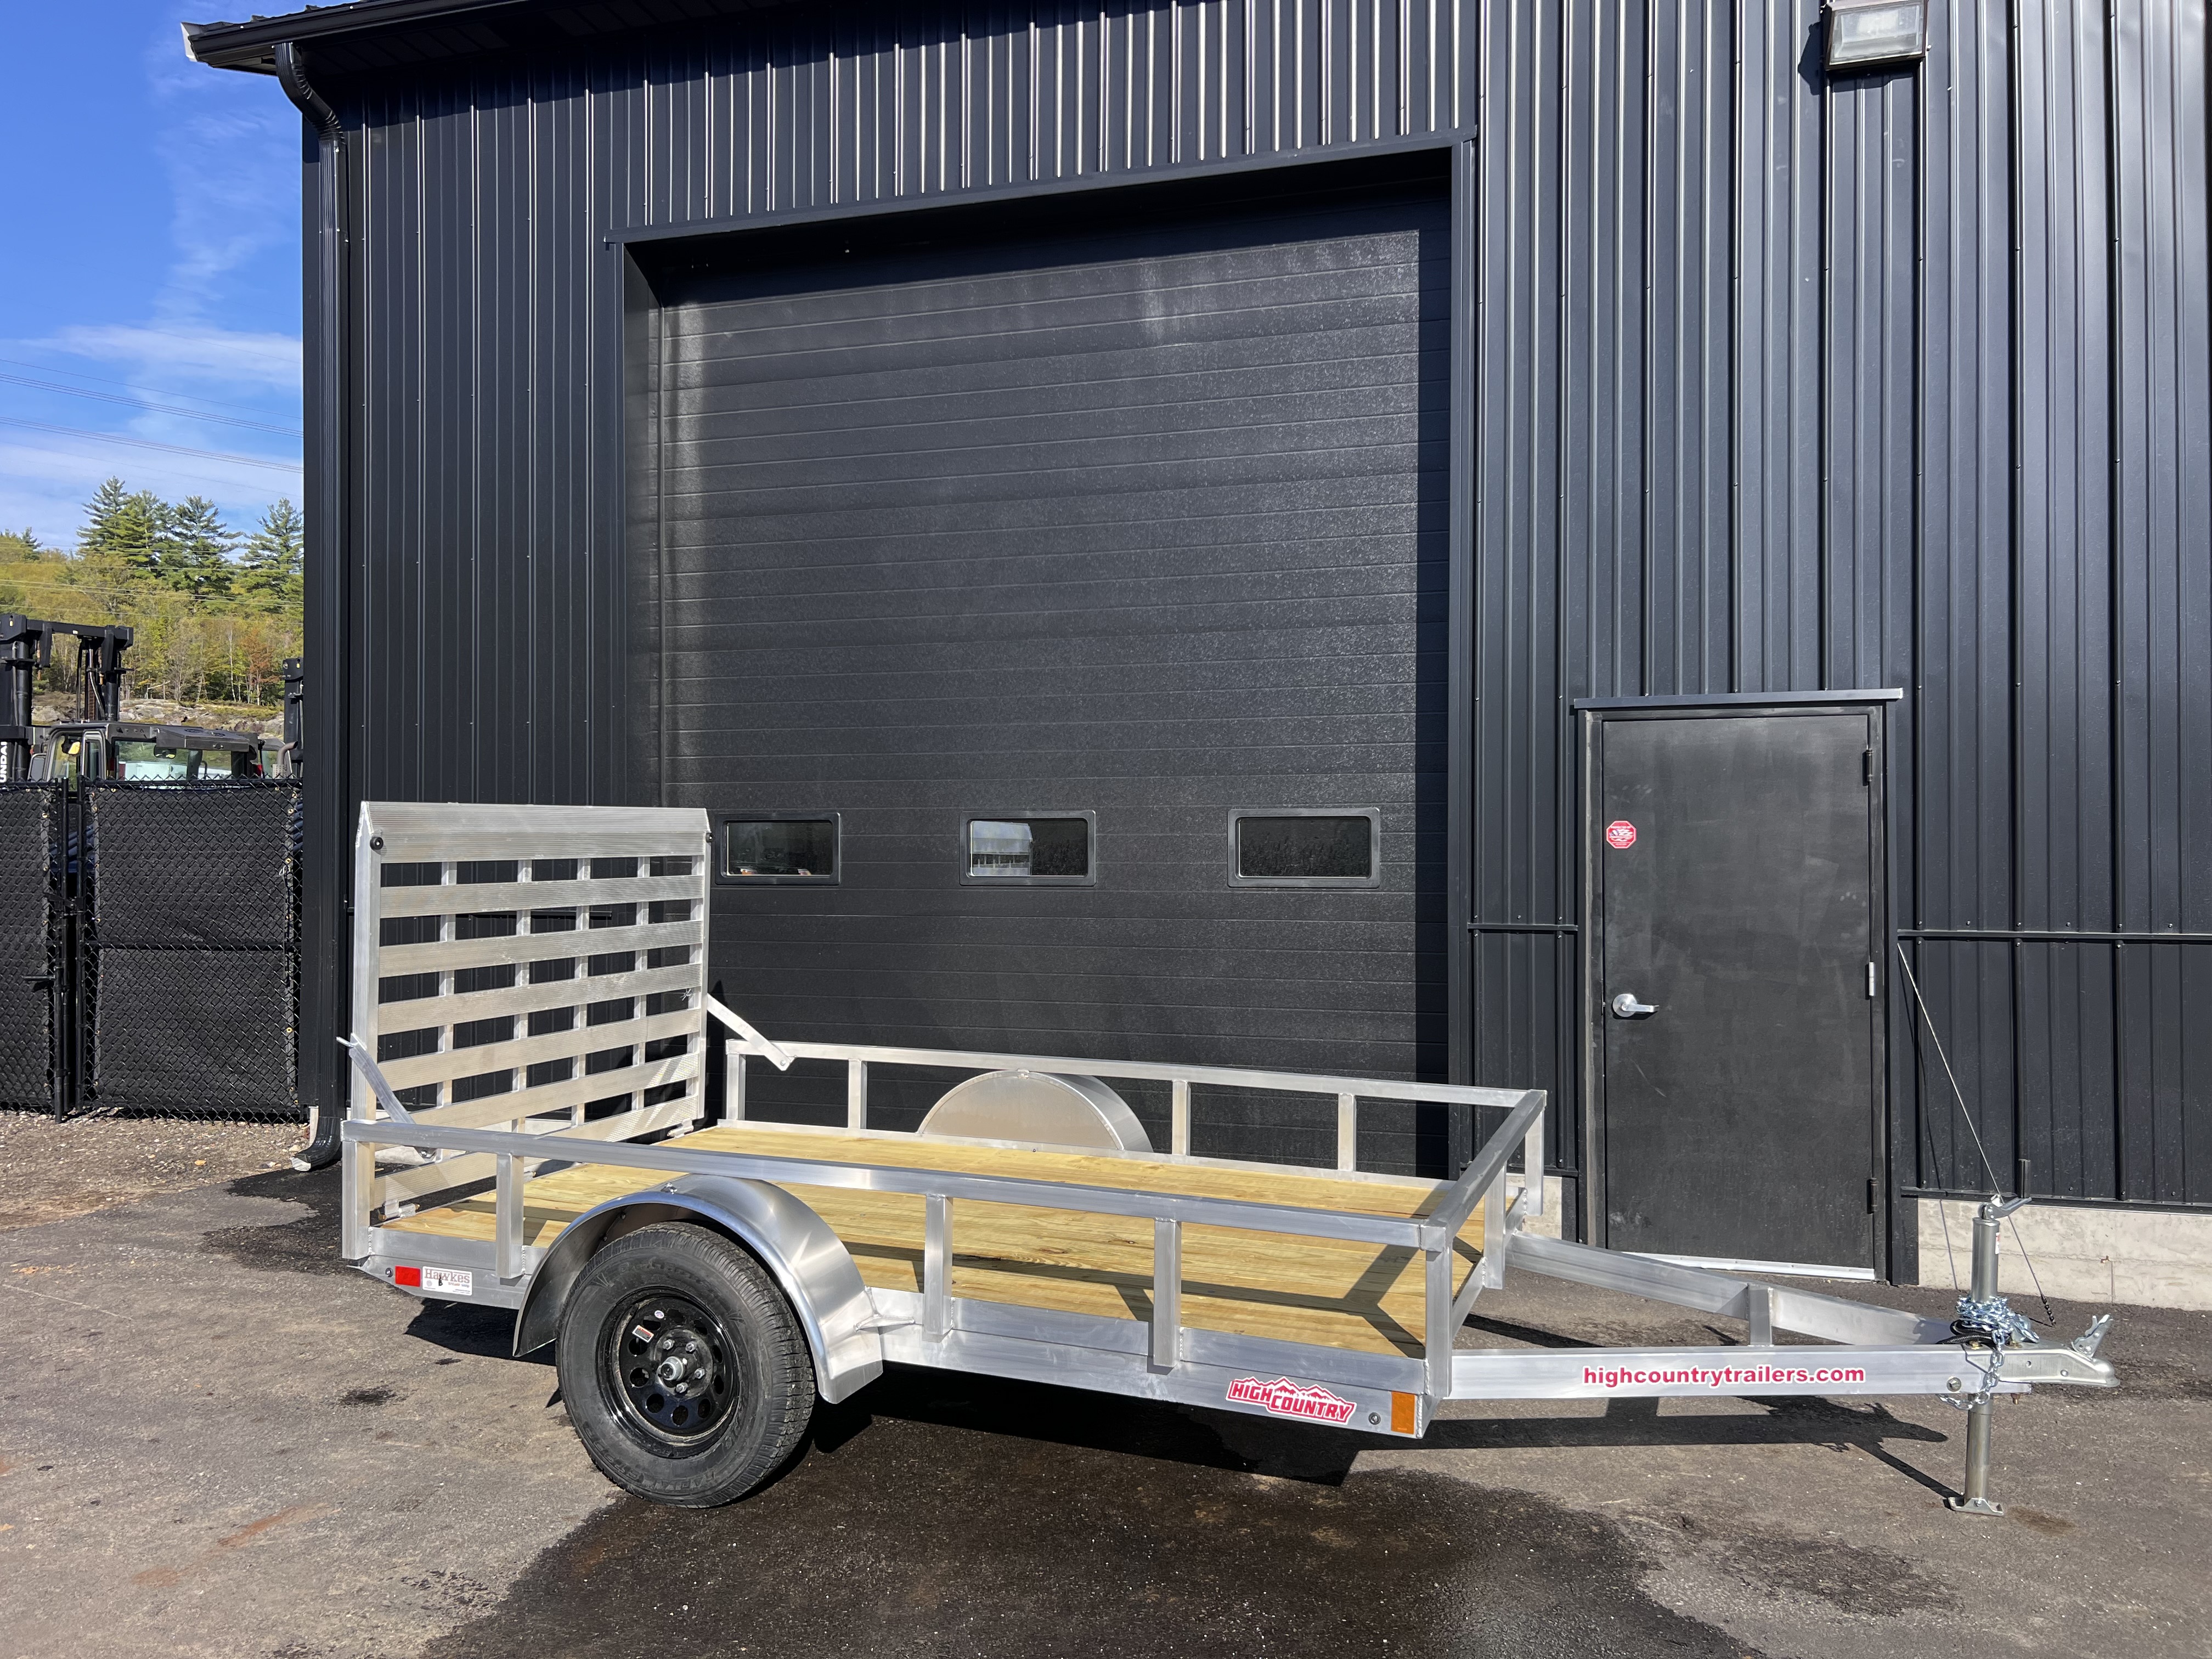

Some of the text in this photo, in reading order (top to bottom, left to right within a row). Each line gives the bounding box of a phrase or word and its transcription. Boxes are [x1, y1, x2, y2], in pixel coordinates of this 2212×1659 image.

[424, 1268, 471, 1284] Hawkes
[1583, 1365, 1865, 1387] highcountrytrailers.com
[1232, 1383, 1273, 1402] HIGH
[1271, 1395, 1351, 1420] COUNTRY
